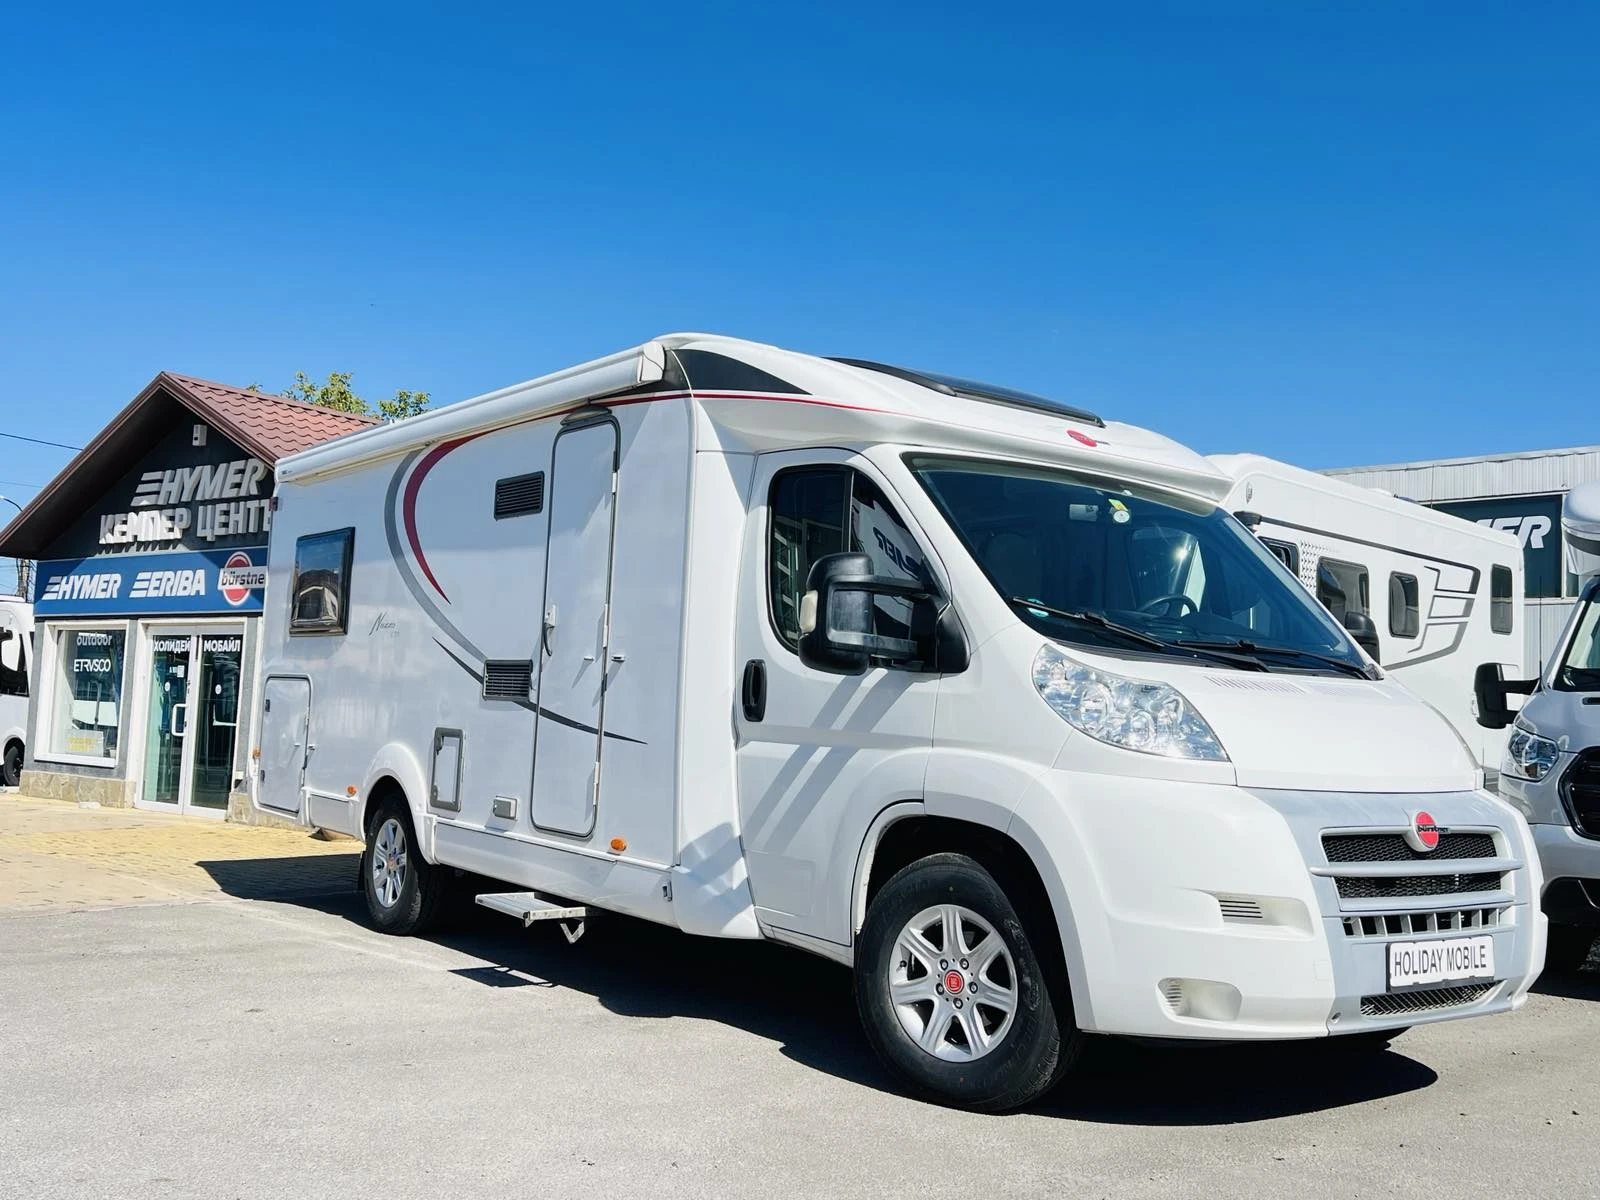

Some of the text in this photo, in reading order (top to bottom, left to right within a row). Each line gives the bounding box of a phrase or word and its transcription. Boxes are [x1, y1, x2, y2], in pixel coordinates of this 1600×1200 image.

[158, 459, 267, 505] HYMER
[99, 507, 191, 544] КЕМПЕР
[57, 573, 122, 600] HYMER
[154, 636, 241, 654] ХОЛИДЕЙ МОБАЙЛ
[1394, 945, 1487, 976] HOLIDAY MOBILE
